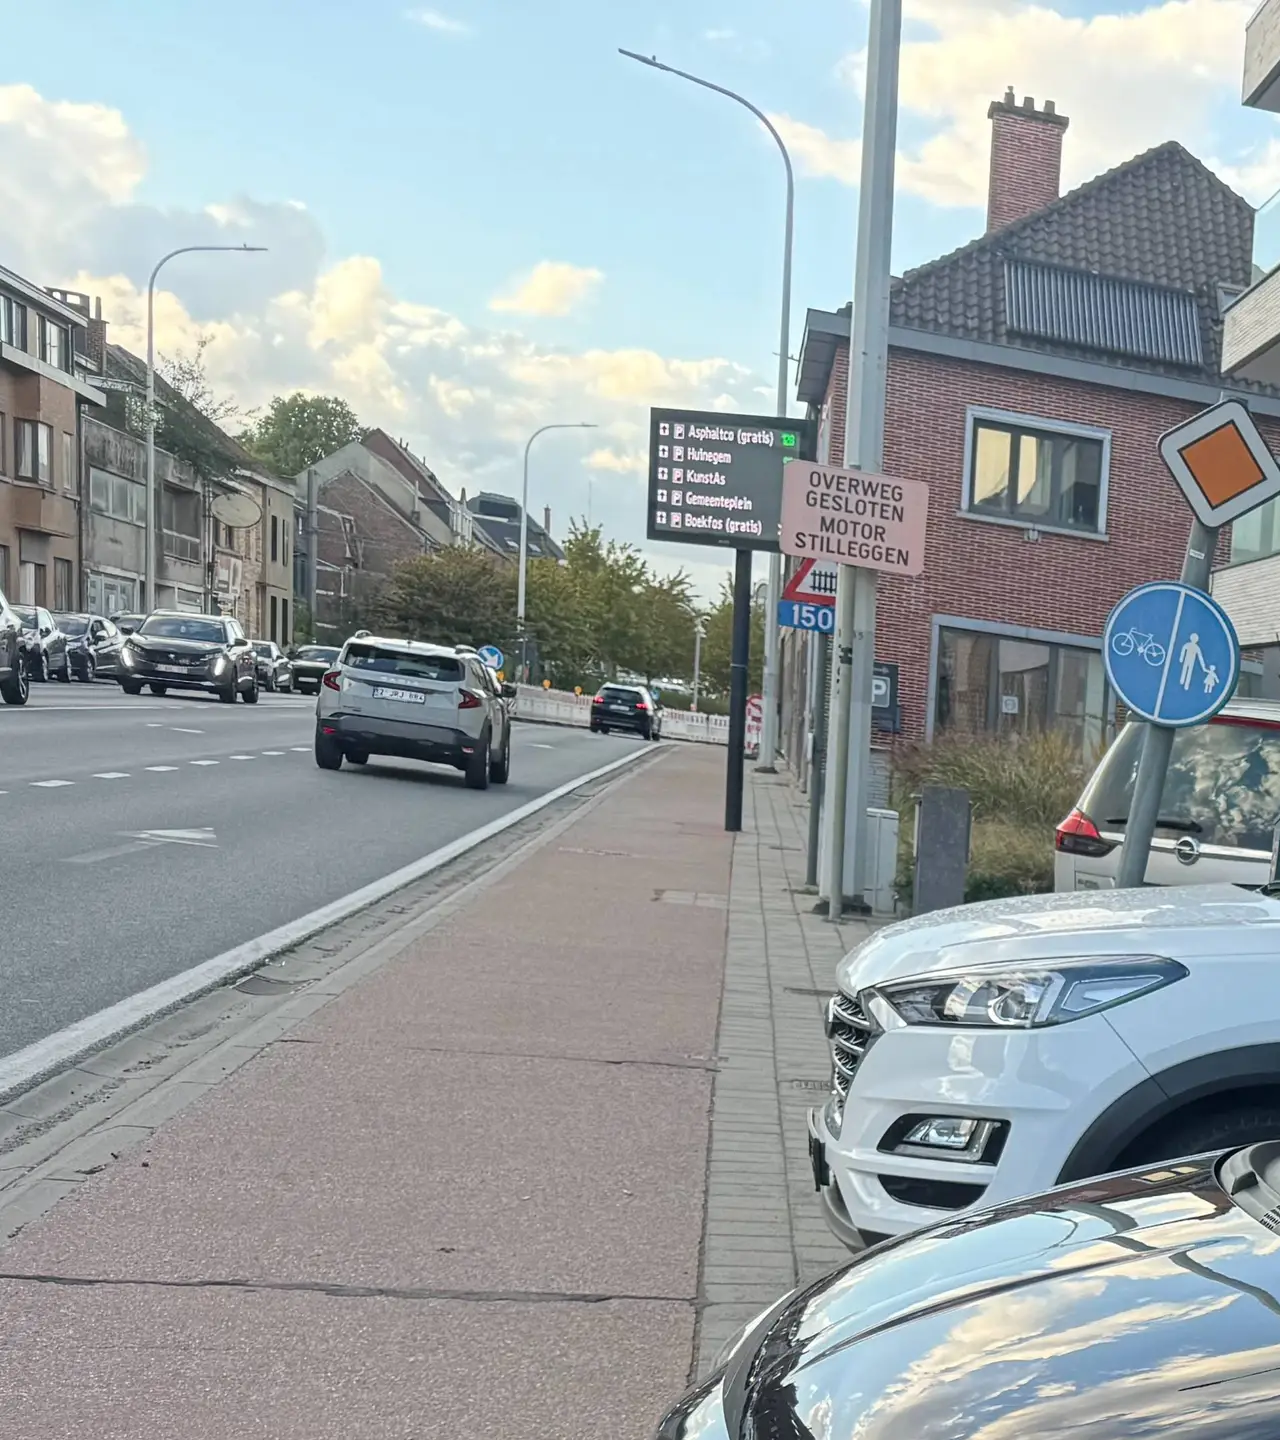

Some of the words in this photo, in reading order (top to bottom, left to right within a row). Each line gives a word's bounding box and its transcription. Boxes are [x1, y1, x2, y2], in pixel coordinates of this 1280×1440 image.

[687, 424, 734, 441] Asphaltco
[737, 428, 774, 447] (gratis)
[687, 447, 732, 464] Huinegem
[686, 469, 726, 485] KunstAs
[809, 471, 903, 502] OVERWEG
[685, 491, 753, 511] Gemeenteplein
[806, 490, 904, 522] GESLOTEN
[725, 517, 762, 536] (gratis)
[820, 516, 886, 542] MOTOR
[795, 532, 909, 566] STILLEGGEN
[791, 604, 832, 630] 150
